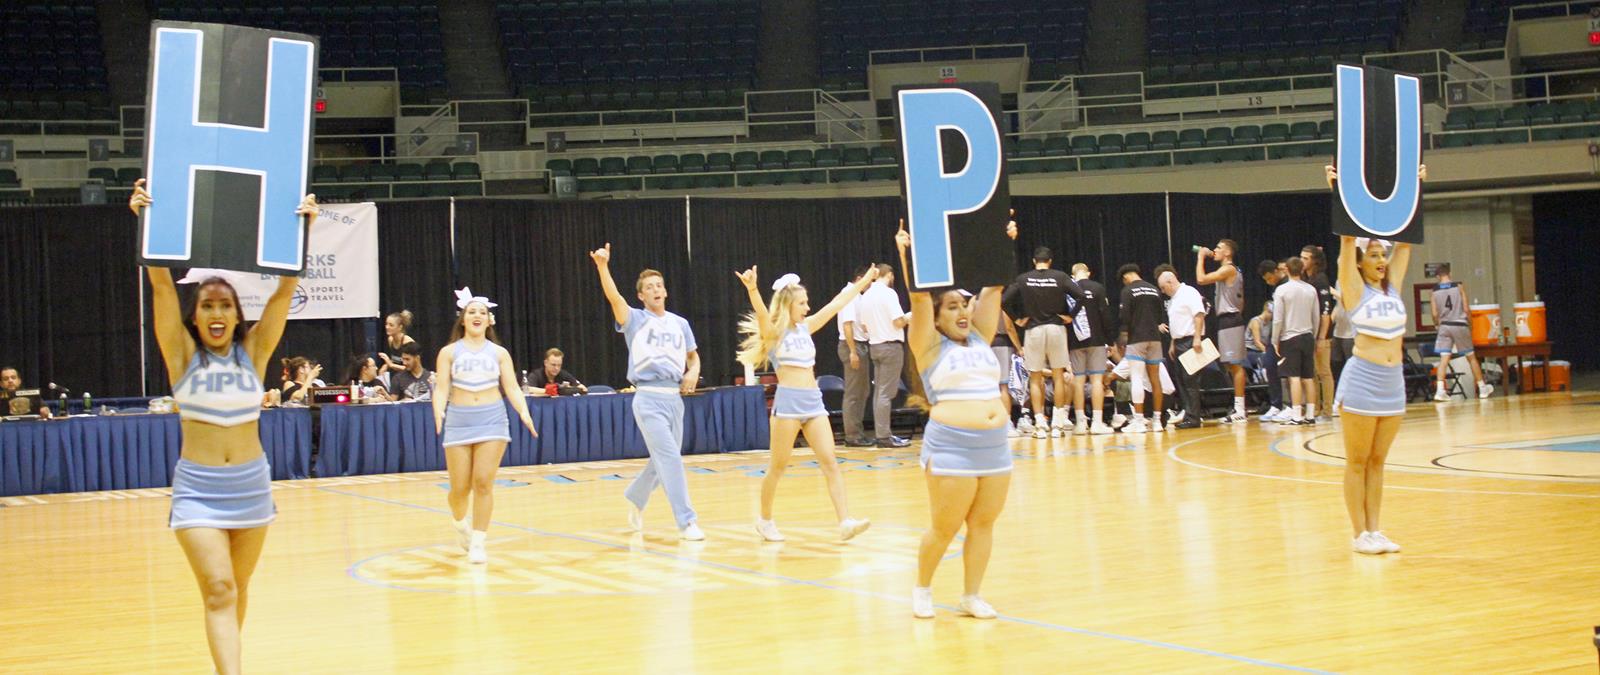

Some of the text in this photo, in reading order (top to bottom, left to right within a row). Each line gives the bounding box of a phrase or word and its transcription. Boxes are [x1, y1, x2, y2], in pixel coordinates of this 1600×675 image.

[1248, 96, 1263, 106] 13
[142, 27, 314, 271] H
[1336, 64, 1419, 236] U
[897, 87, 1002, 289] P
[317, 208, 357, 226] OME OF
[1445, 294, 1453, 311] 4
[646, 328, 683, 350] HPU
[455, 359, 496, 374] HPU
[950, 351, 998, 371] HPU
[190, 372, 257, 396] HPU
